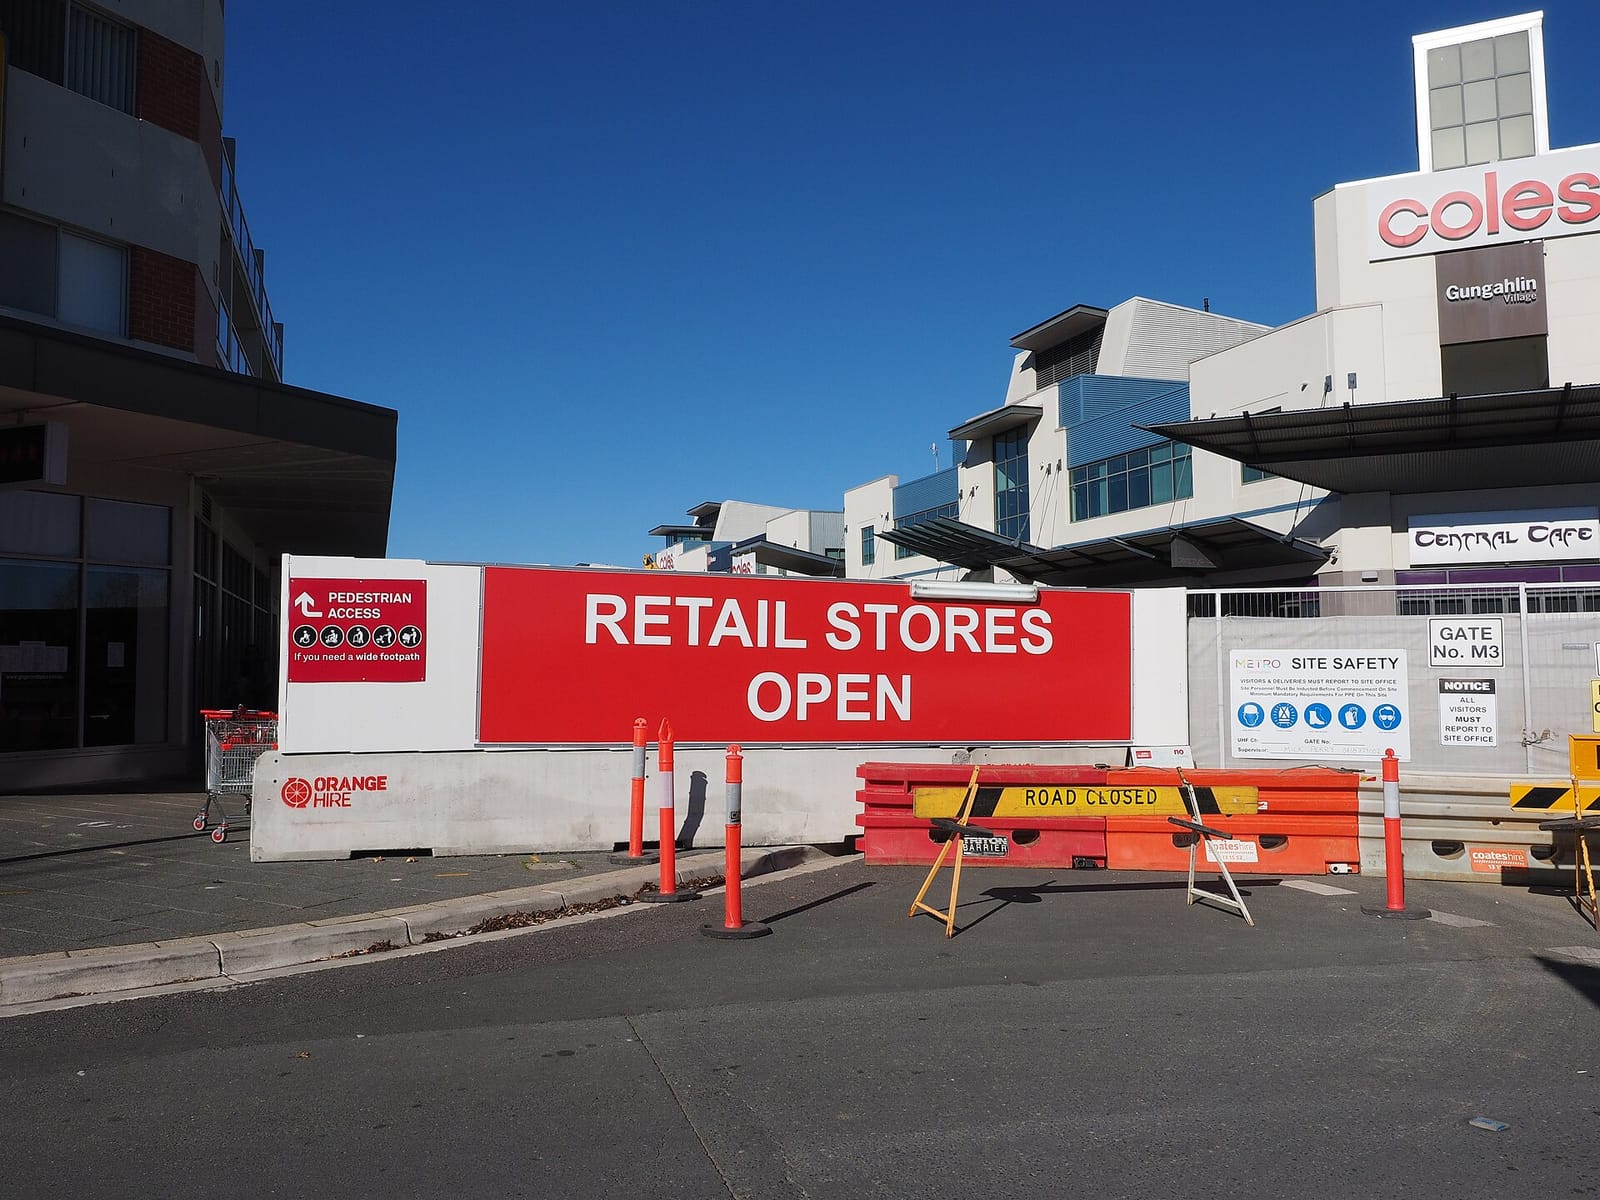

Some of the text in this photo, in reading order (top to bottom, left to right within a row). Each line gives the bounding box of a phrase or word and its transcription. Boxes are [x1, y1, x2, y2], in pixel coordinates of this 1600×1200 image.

[1378, 172, 1600, 248] coles
[1446, 277, 1537, 301] Gungahlin
[1503, 293, 1537, 304] Village
[328, 592, 412, 604] PEDESTRIAN
[327, 607, 381, 619] ACCESS
[585, 593, 1054, 656] RETAIL STORES
[1439, 627, 1493, 641] GATE
[294, 653, 302, 661] If
[303, 654, 320, 663] you
[322, 653, 346, 662] need
[356, 653, 378, 661] wide
[380, 653, 420, 663] footpath
[1433, 644, 1500, 659] No. M3
[1235, 657, 1399, 670] METRO SITE SAFETY
[1444, 681, 1491, 691] NOTICE
[747, 671, 912, 722] OPEN
[1464, 735, 1494, 743] OFFICE
[314, 775, 388, 792] ORANGE
[313, 792, 352, 808] HIRE
[1025, 788, 1157, 806] ROAD CLOSED
[962, 844, 1008, 852] BARRIER
